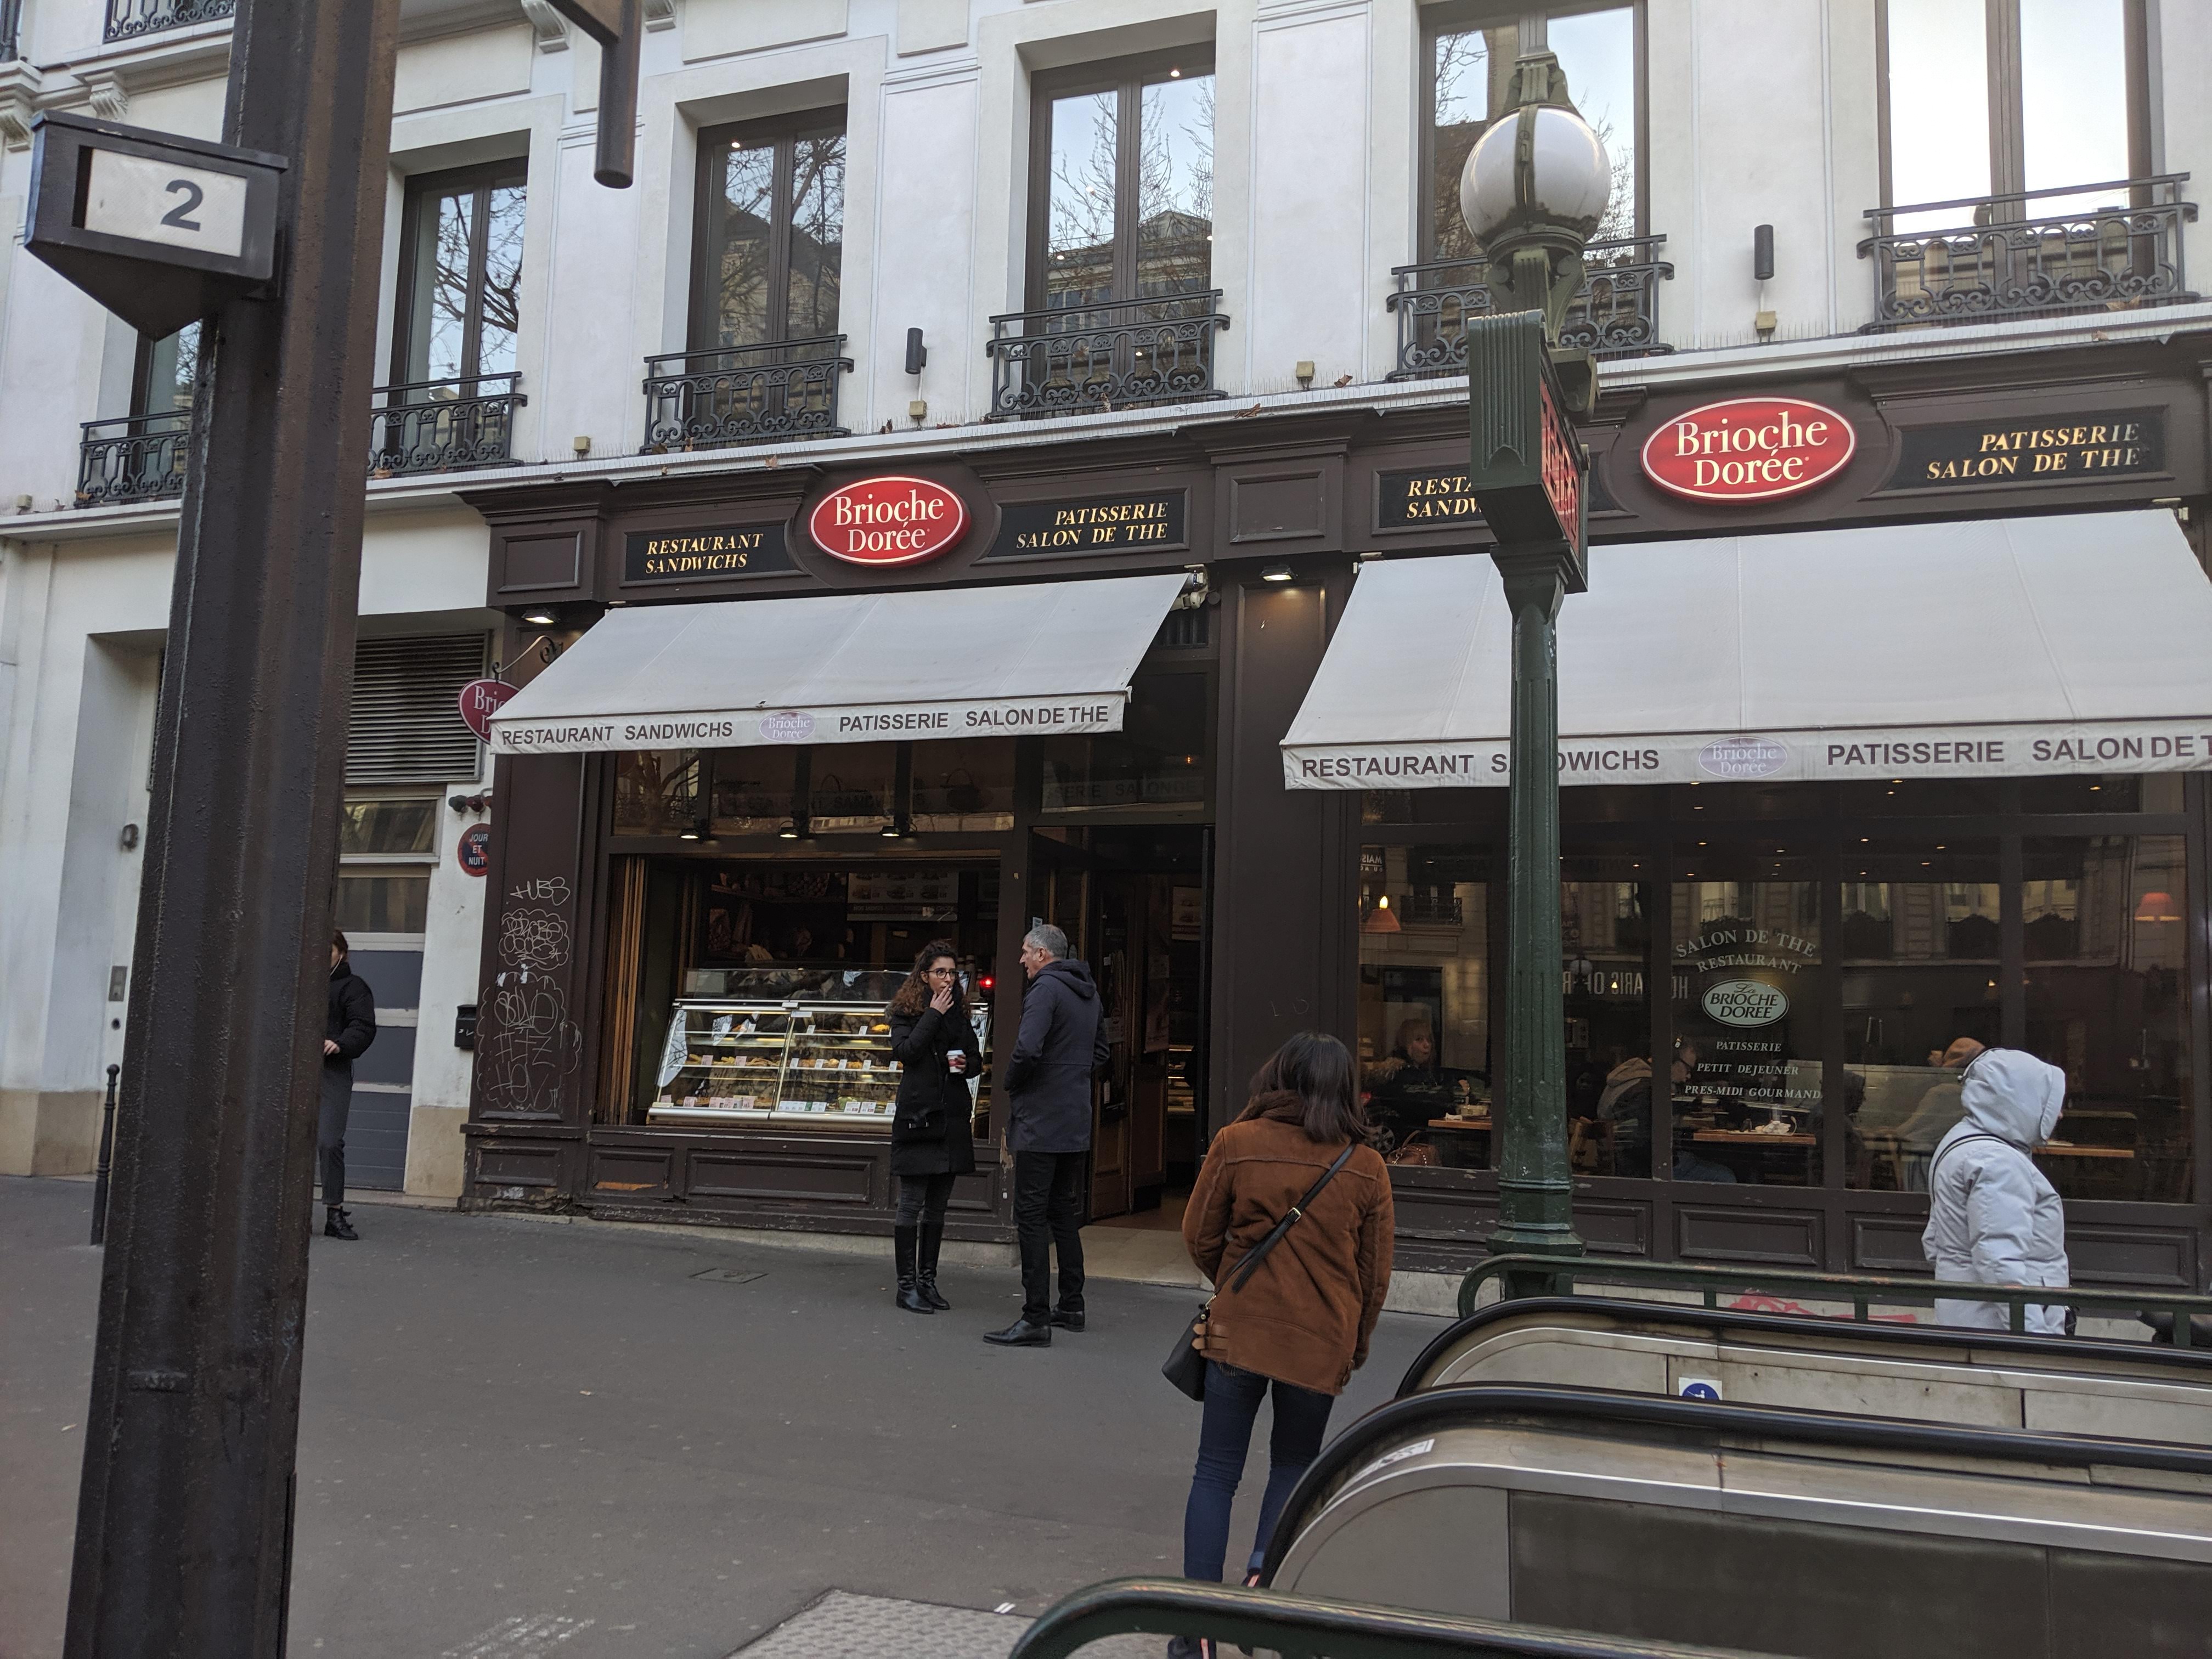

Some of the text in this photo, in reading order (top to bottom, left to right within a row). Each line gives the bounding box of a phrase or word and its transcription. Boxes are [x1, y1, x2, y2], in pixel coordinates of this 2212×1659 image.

[160, 179, 204, 232] 2
[1675, 410, 1828, 456] Brioche
[1979, 423, 2140, 453] PATISSERIE
[1693, 449, 1804, 487] Dorée
[1927, 448, 2140, 479] SALON DE THE
[834, 489, 945, 527] Brioche
[1054, 502, 1169, 526] PATISSERIE
[647, 533, 764, 555] RESTAURANT
[847, 521, 926, 552] Dorée
[1016, 523, 1169, 549] SALON DE THE
[645, 553, 748, 574] SANDWICHS
[768, 715, 810, 729] Brioche
[839, 712, 949, 732] PATISSERIE
[502, 721, 733, 745] RESTAURANT SANDWICHS
[1712, 743, 1777, 760] Brioche
[1827, 741, 2005, 766] PATISSERIE
[2032, 737, 2143, 761] SALON
[2151, 736, 2195, 758] DE
[1302, 749, 1660, 778] RESTAURANT SWICHS
[1720, 759, 1767, 773] Dorée
[469, 833, 488, 842] JOUR
[472, 845, 482, 854] ET
[469, 856, 484, 865] NUIT
[1676, 929, 1816, 958] SALON DE THE
[1696, 953, 1802, 974] RESTAURANT
[1710, 993, 1779, 1006] BRIOCHE
[1720, 1006, 1773, 1018] DOREE
[1716, 1041, 1782, 1052] PATISSERIE
[1697, 1063, 1799, 1076] PETIT DEJEUNER
[1685, 1085, 1821, 1099] PRES-MIDI GOURMAND
